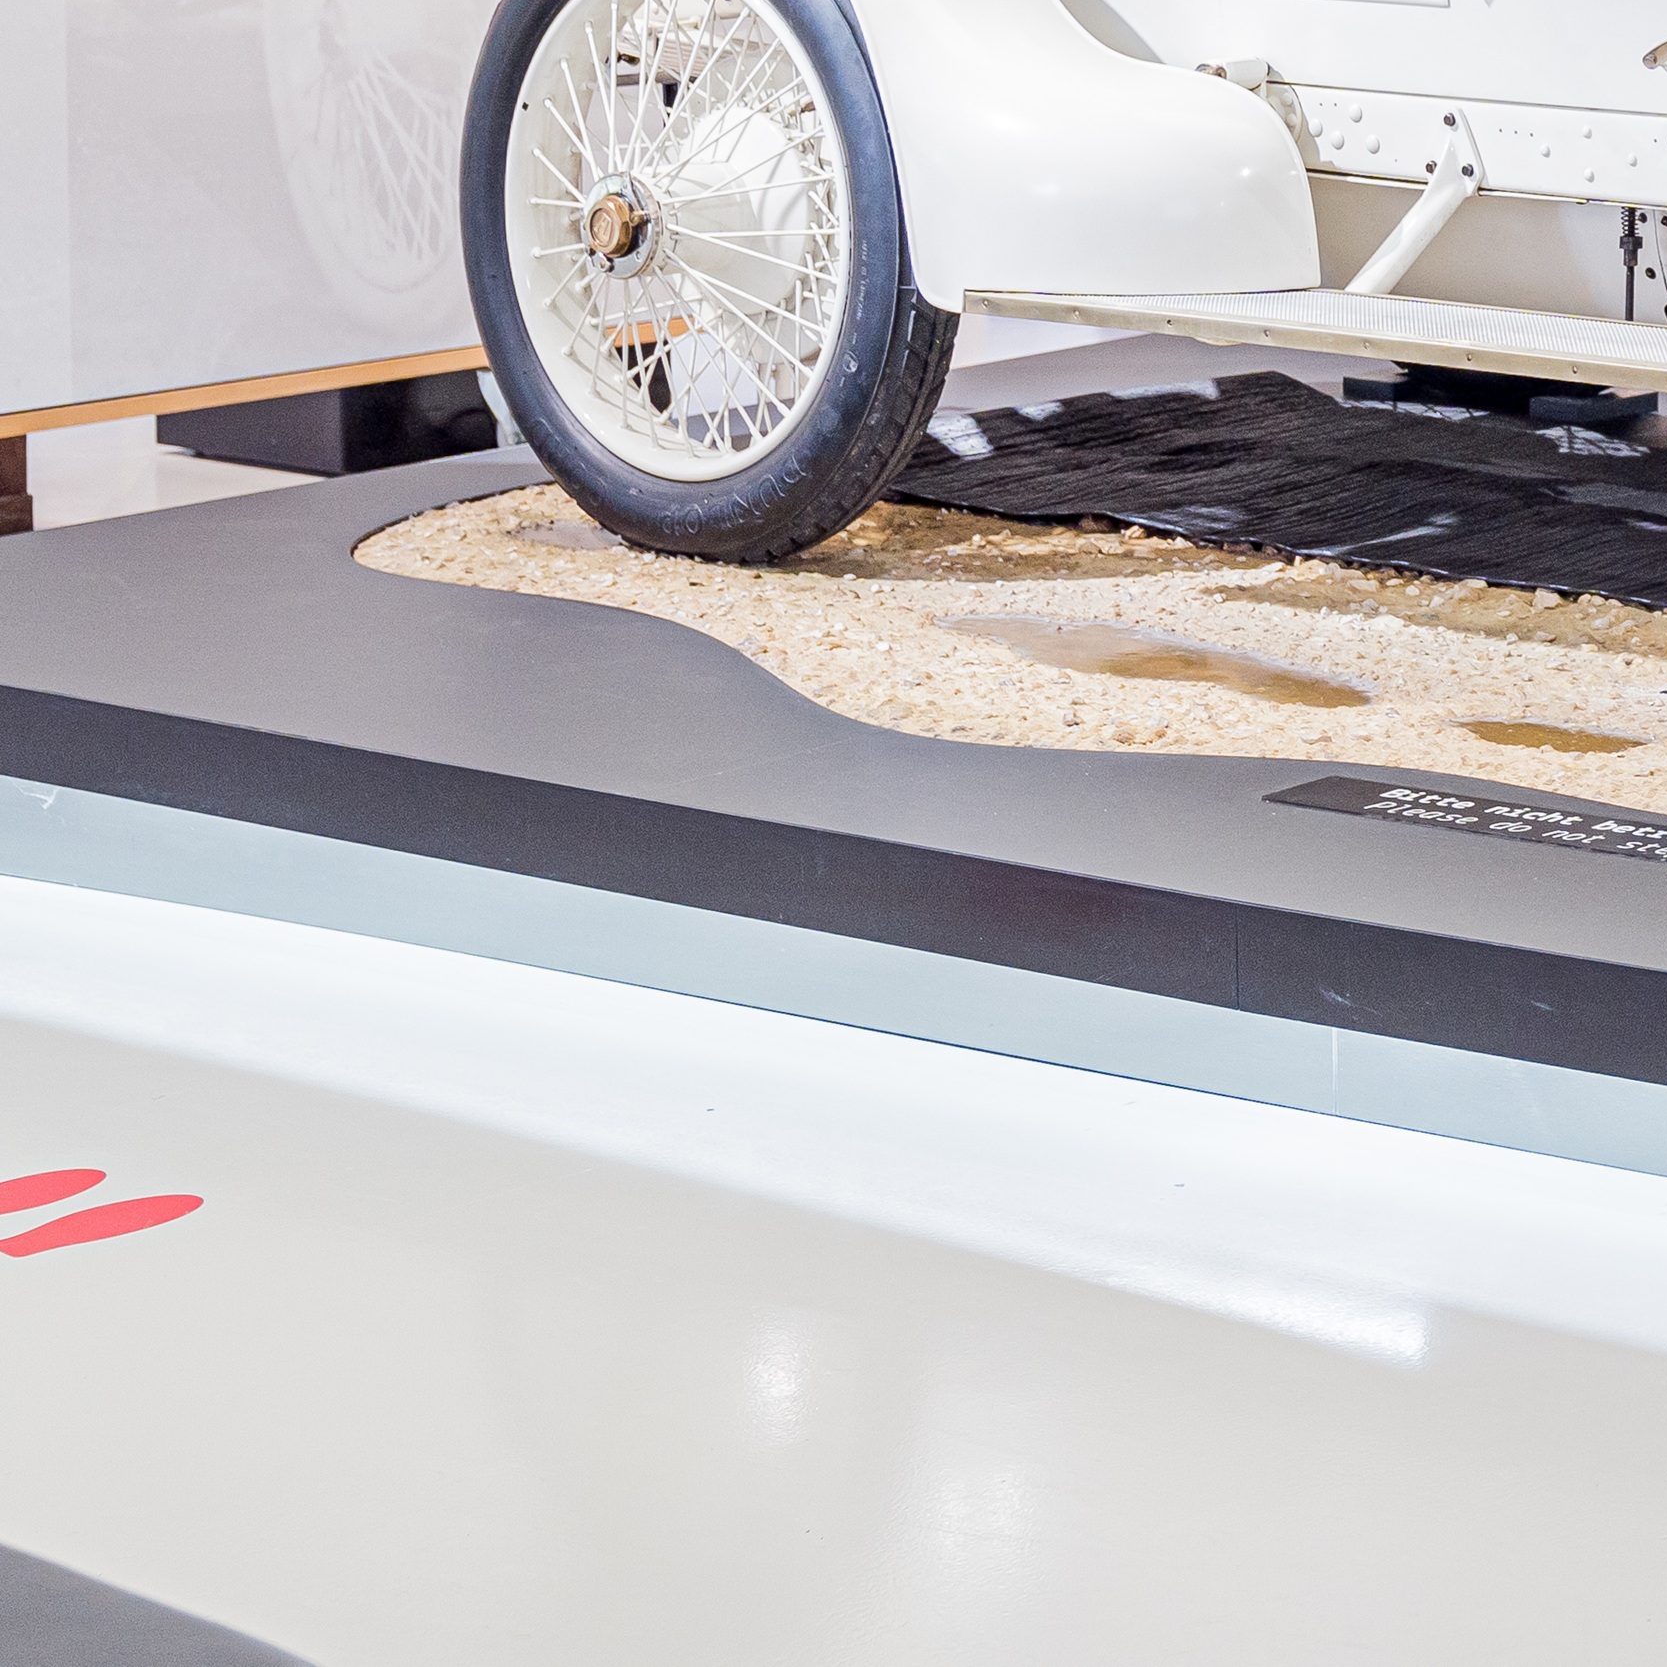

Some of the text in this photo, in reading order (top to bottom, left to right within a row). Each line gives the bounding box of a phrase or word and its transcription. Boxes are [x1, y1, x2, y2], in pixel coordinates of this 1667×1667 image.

[1363, 801, 1479, 825] Please
[1488, 821, 1533, 833] do
[1541, 829, 1606, 844] not
[1380, 788, 1477, 810] Bitte
[1484, 805, 1583, 826] nicht
